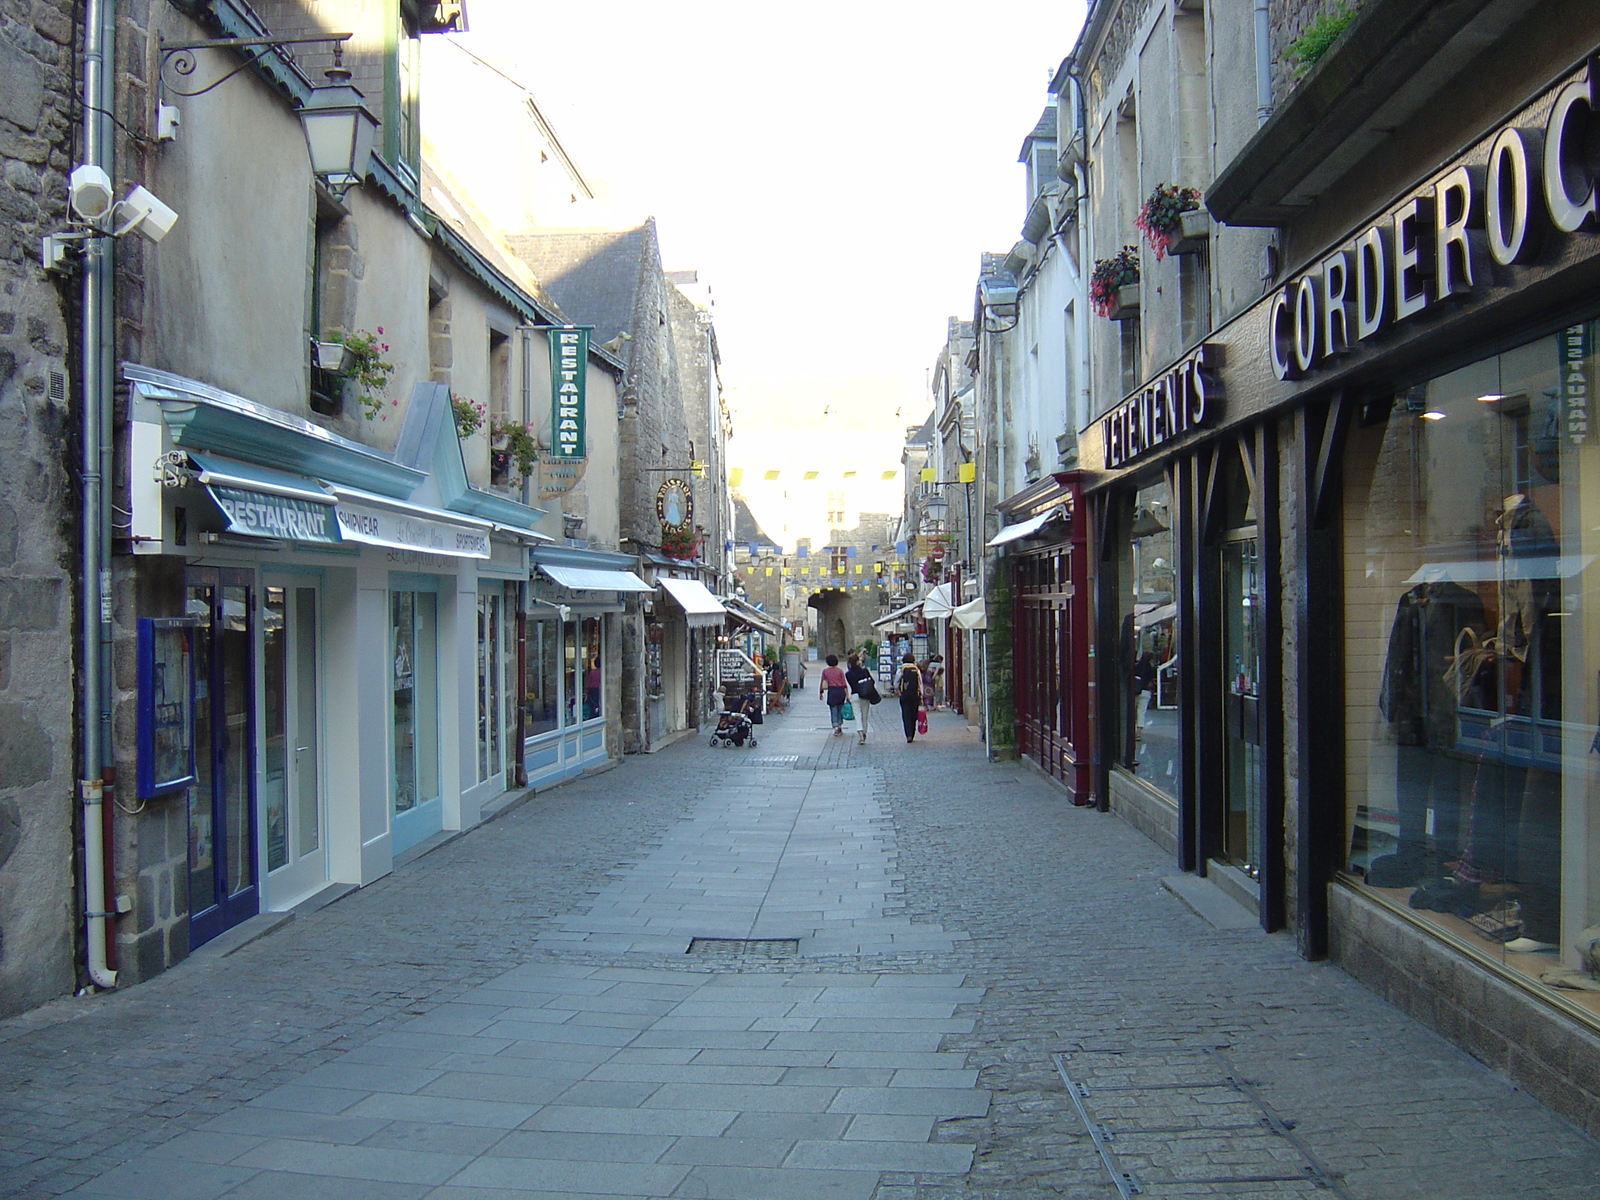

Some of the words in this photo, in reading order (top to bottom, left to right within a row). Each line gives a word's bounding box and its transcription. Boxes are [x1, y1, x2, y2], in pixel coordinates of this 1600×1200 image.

[1269, 81, 1598, 382] CORDEROC
[559, 333, 579, 454] RESTAURANT
[1101, 350, 1204, 468] VETEMENTS
[221, 498, 326, 535] RESTAURANT
[338, 511, 380, 537] SHIPWEAR
